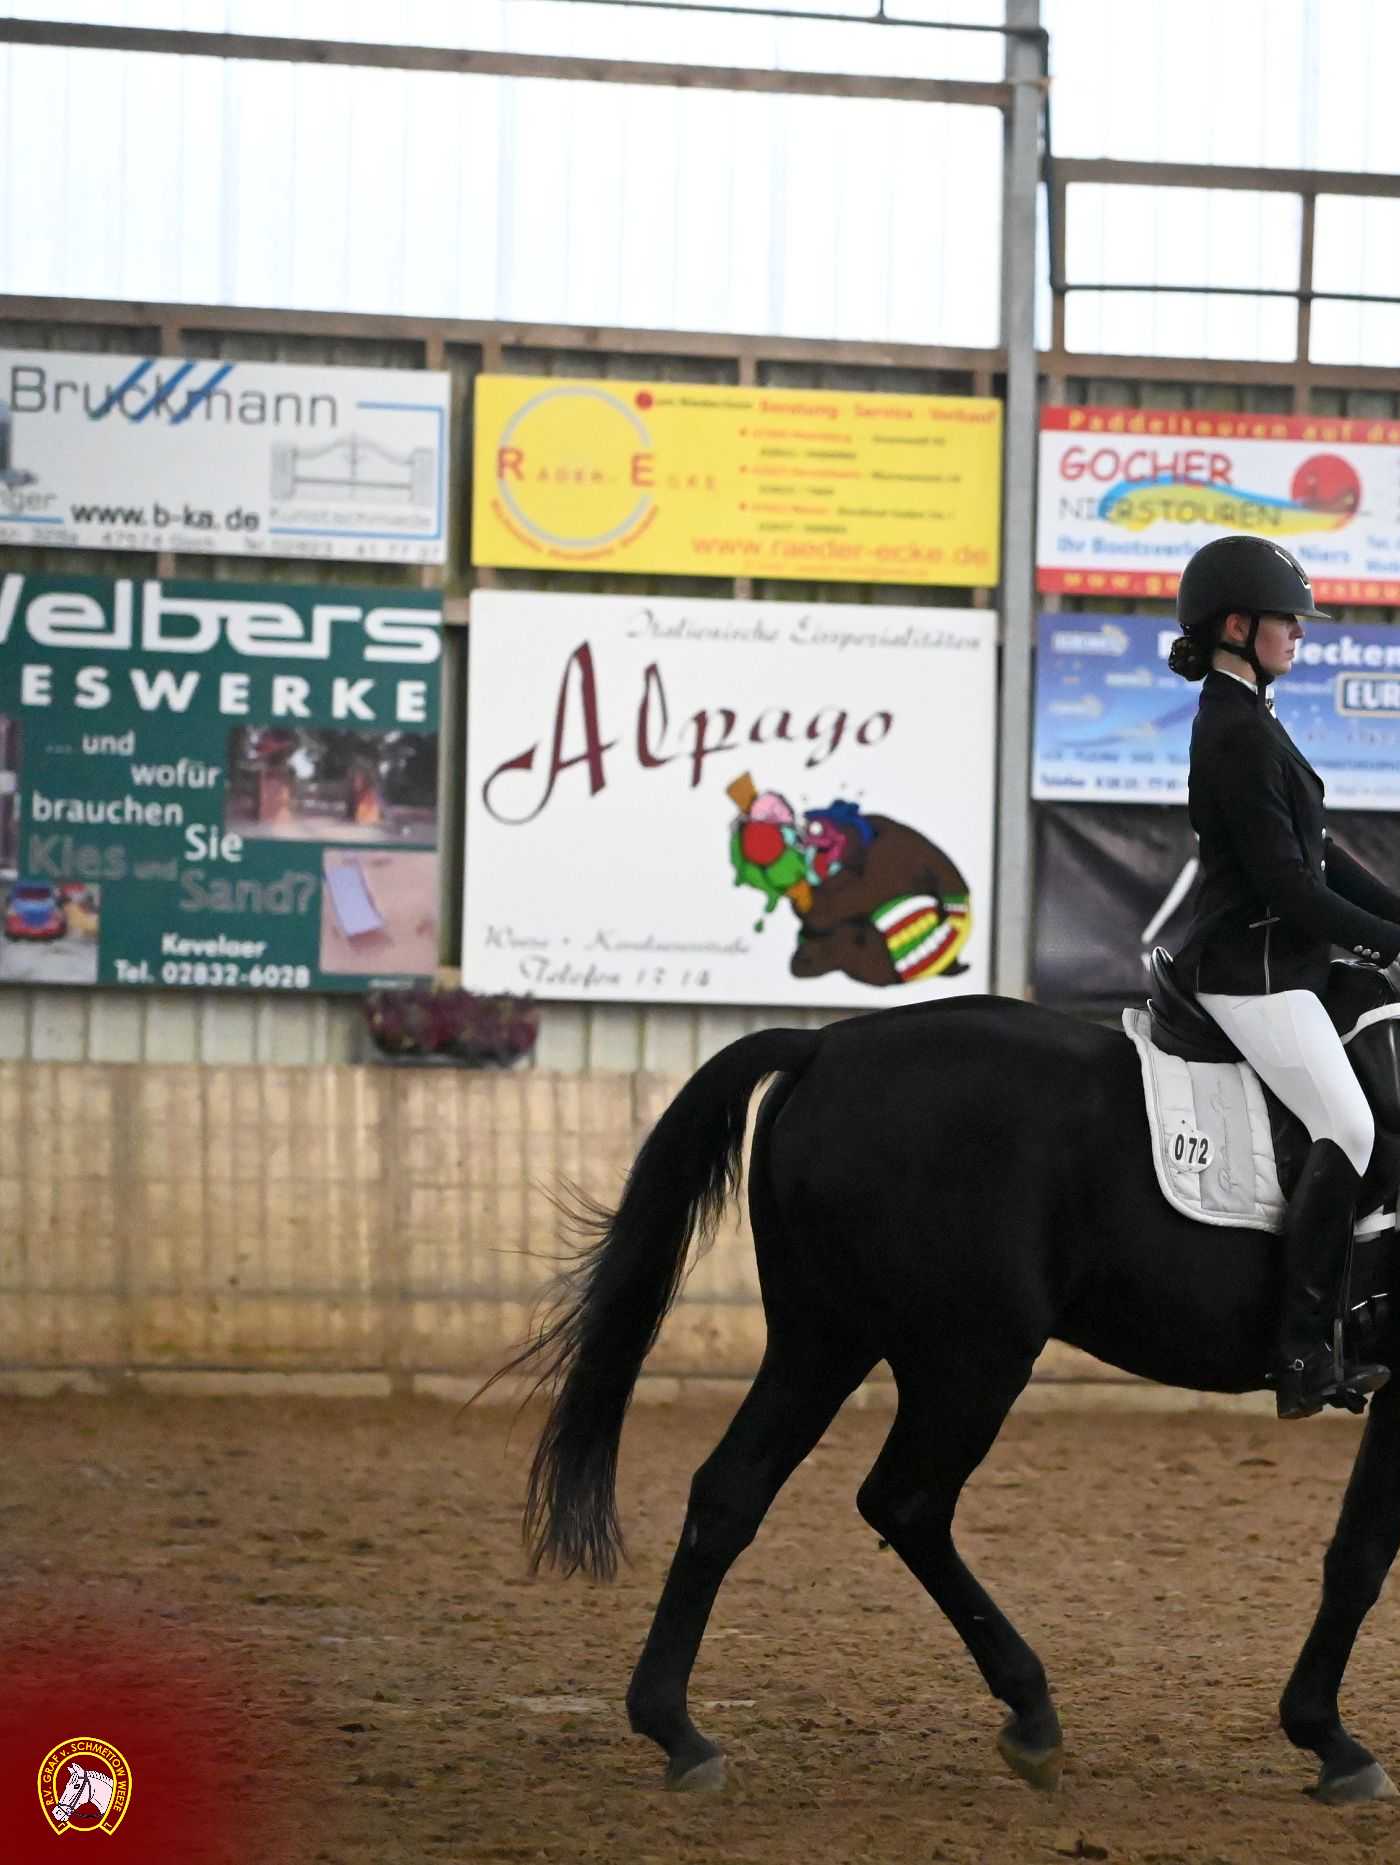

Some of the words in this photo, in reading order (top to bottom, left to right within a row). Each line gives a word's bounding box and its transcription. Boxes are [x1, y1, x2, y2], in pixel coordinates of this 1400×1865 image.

[10, 365, 338, 426] Bruckmann
[1060, 446, 1234, 486] GOCHER
[71, 502, 260, 532] www.b-ka.de
[21, 664, 428, 723] ESWERKE
[81, 729, 136, 757] und
[482, 640, 894, 825] Alpago
[130, 757, 222, 788] wofür
[31, 789, 185, 827] brauchen
[183, 822, 244, 863] Sie
[178, 867, 317, 915] Sand?
[160, 932, 267, 959] Kevelaer
[114, 958, 154, 984] Tel.
[160, 961, 311, 989] 02832-6028
[1174, 1133, 1209, 1165] 072
